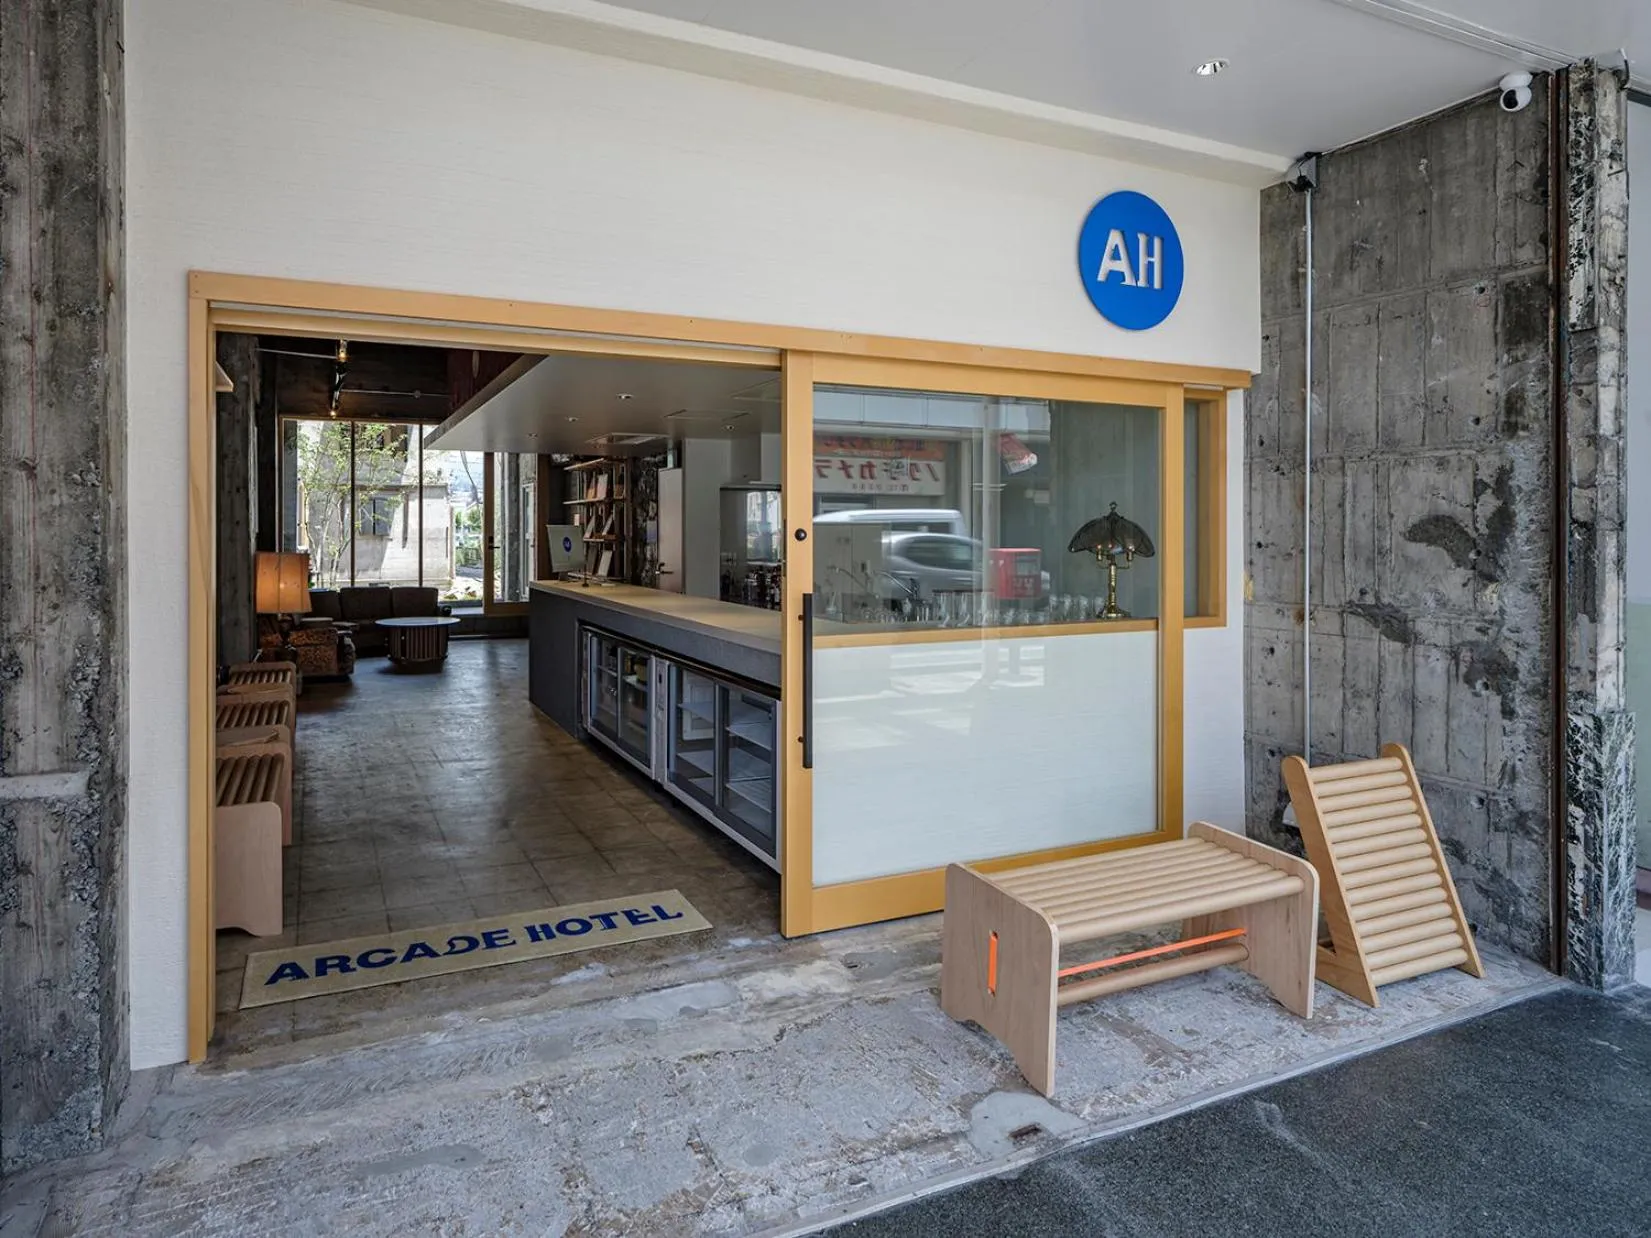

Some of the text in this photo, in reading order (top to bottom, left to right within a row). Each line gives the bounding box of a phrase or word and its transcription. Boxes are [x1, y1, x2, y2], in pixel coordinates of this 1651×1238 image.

[1096, 228, 1163, 290] AH
[264, 904, 683, 985] ARCADE HOTEL
